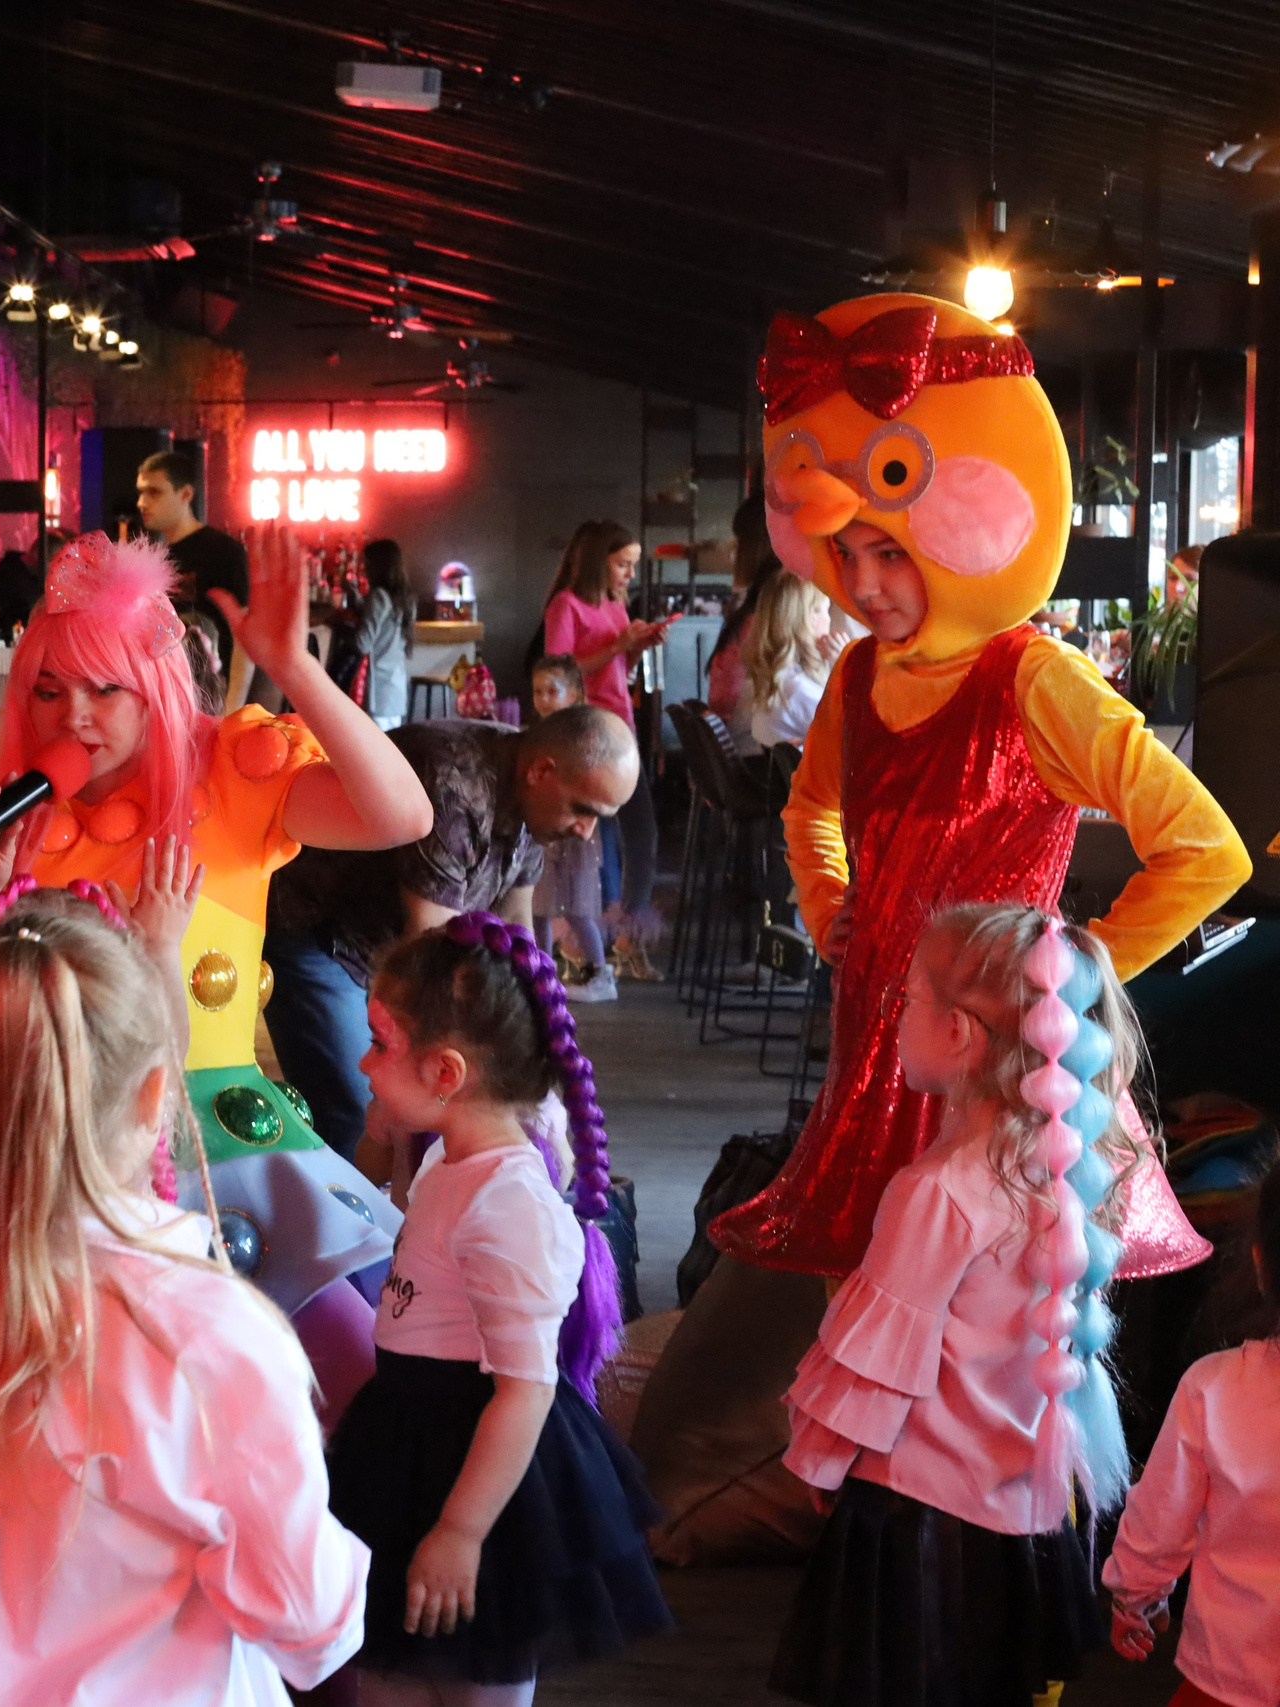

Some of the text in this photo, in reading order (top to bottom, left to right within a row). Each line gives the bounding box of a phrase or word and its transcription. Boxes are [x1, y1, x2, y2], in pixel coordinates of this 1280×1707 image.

[252, 429, 446, 472] ALL YOU NEED
[250, 478, 361, 522] IS LOVE
